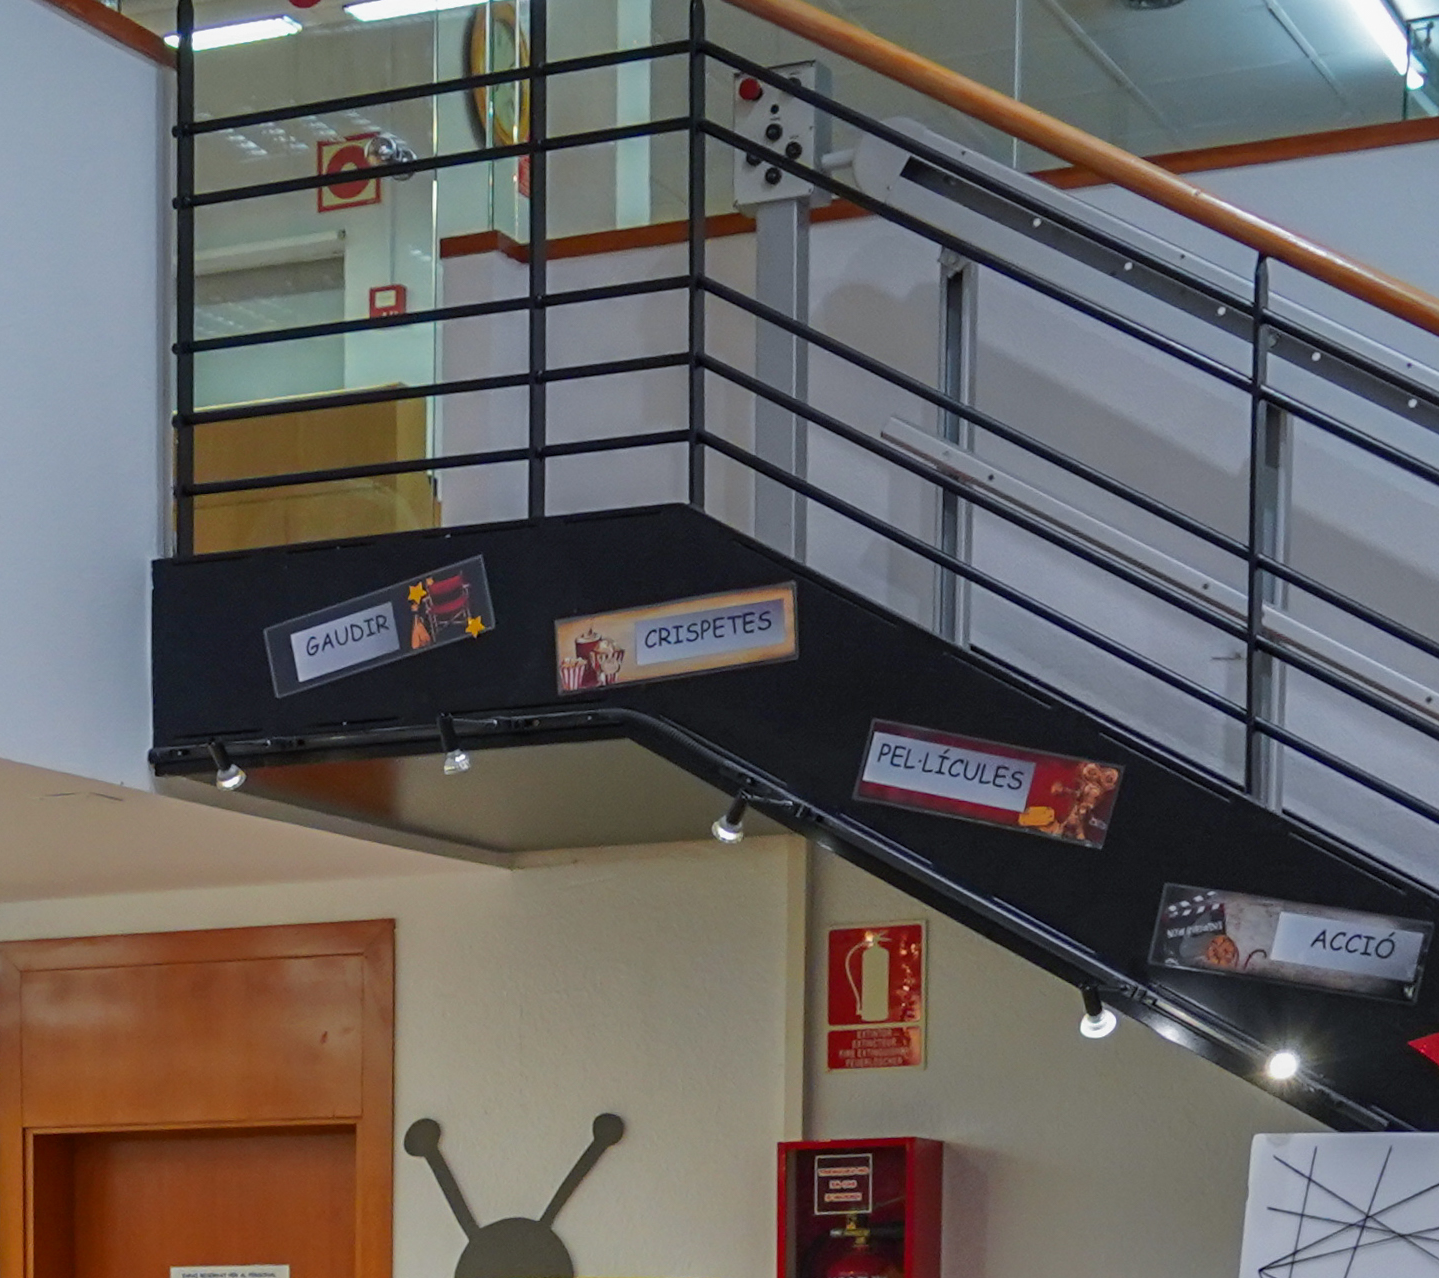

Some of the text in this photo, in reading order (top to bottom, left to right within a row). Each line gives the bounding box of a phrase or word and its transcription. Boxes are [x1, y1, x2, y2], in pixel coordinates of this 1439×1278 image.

[305, 613, 391, 657] GAUDIR
[643, 608, 774, 649] CRISPETES
[1311, 930, 1395, 959] ACCIÓ
